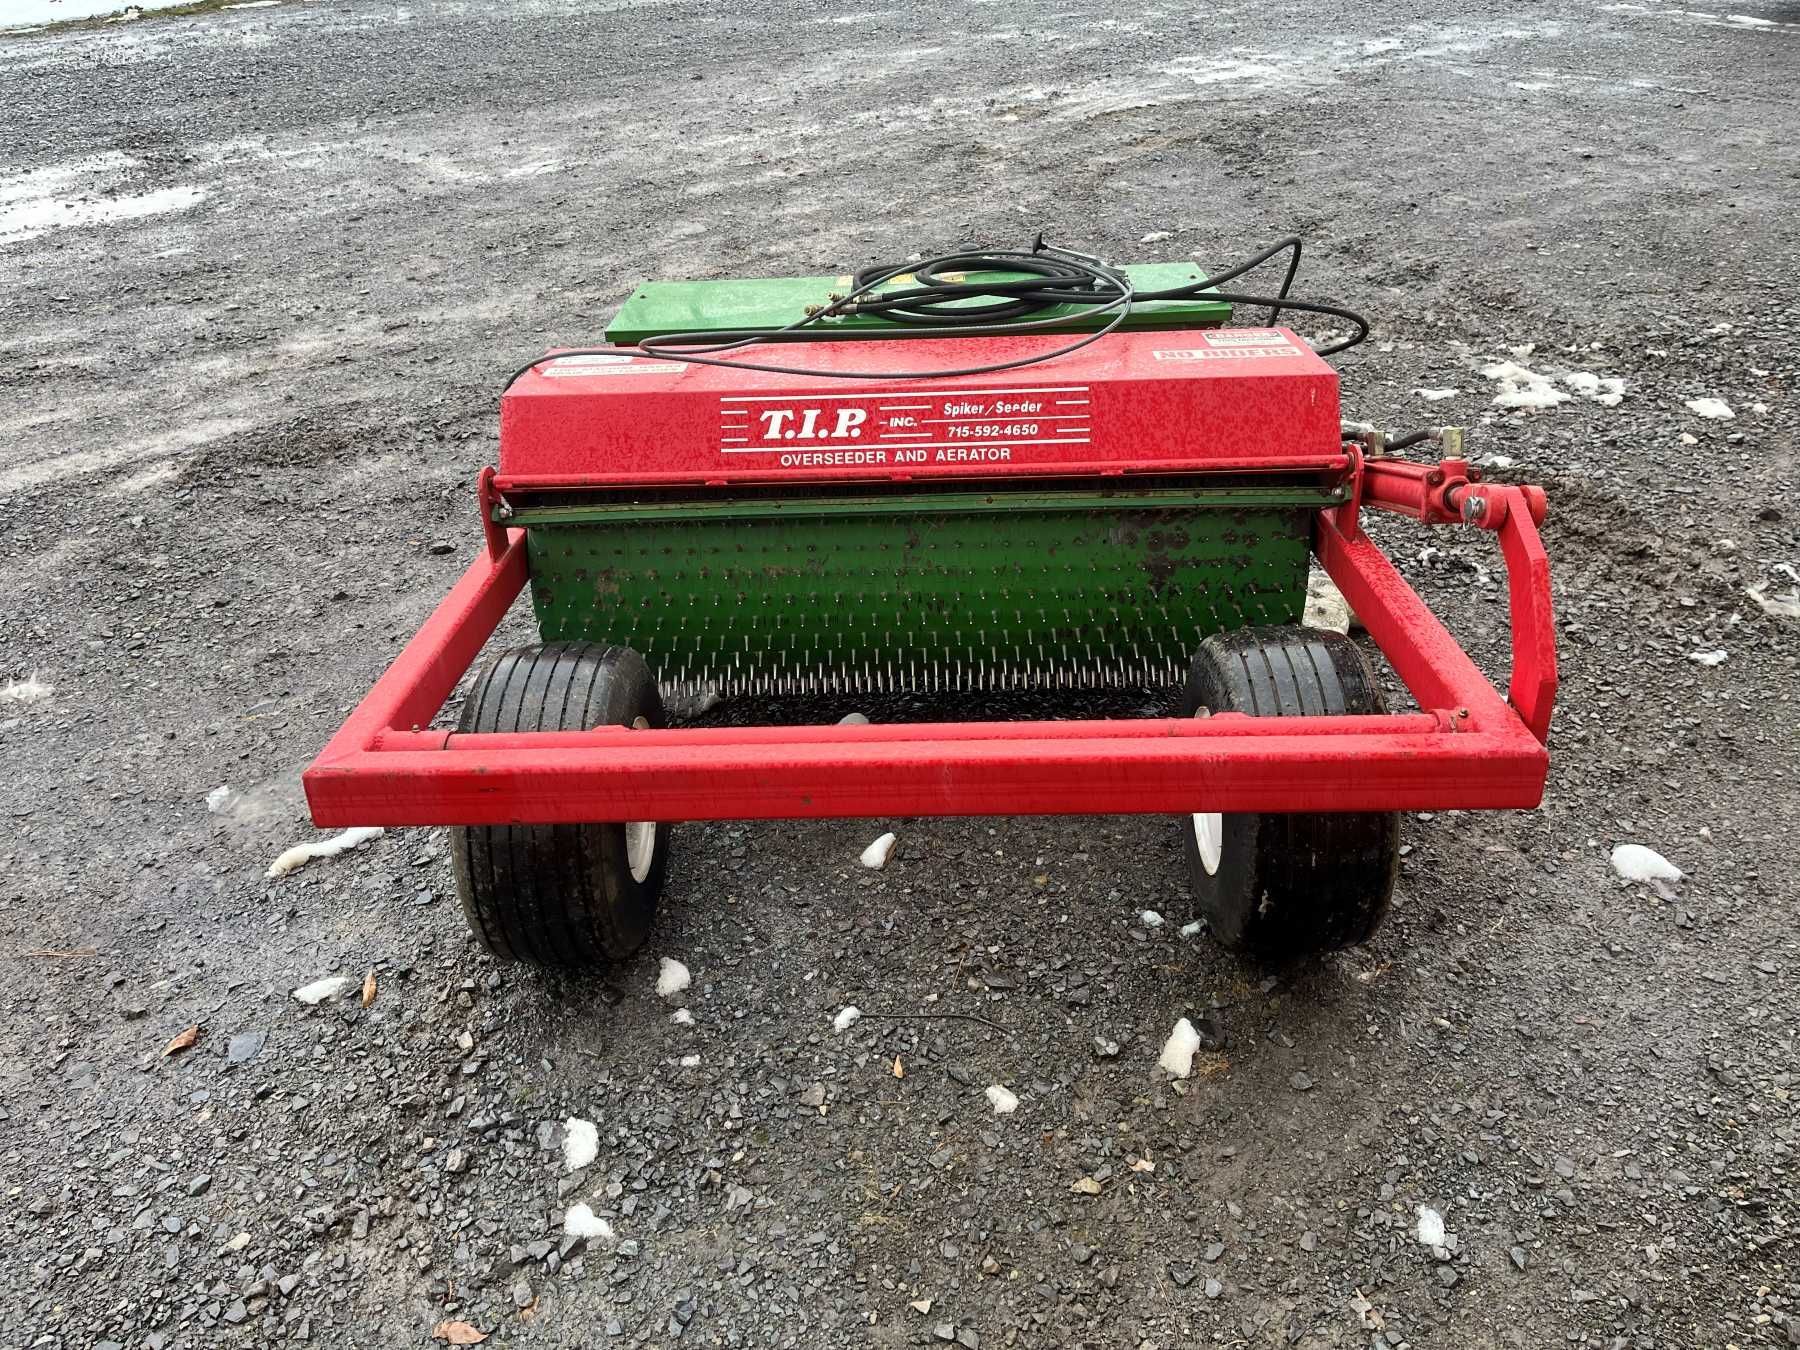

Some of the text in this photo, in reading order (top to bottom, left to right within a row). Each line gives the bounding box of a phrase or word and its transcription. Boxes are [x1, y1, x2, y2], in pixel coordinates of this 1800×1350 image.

[1160, 347, 1298, 359] NO RIDERS
[759, 408, 867, 439] T.I.P.
[889, 417, 918, 428] INC.
[948, 424, 1039, 438] 715-592-4650
[780, 447, 1011, 467] OVERSEEDER AND AERATOR
